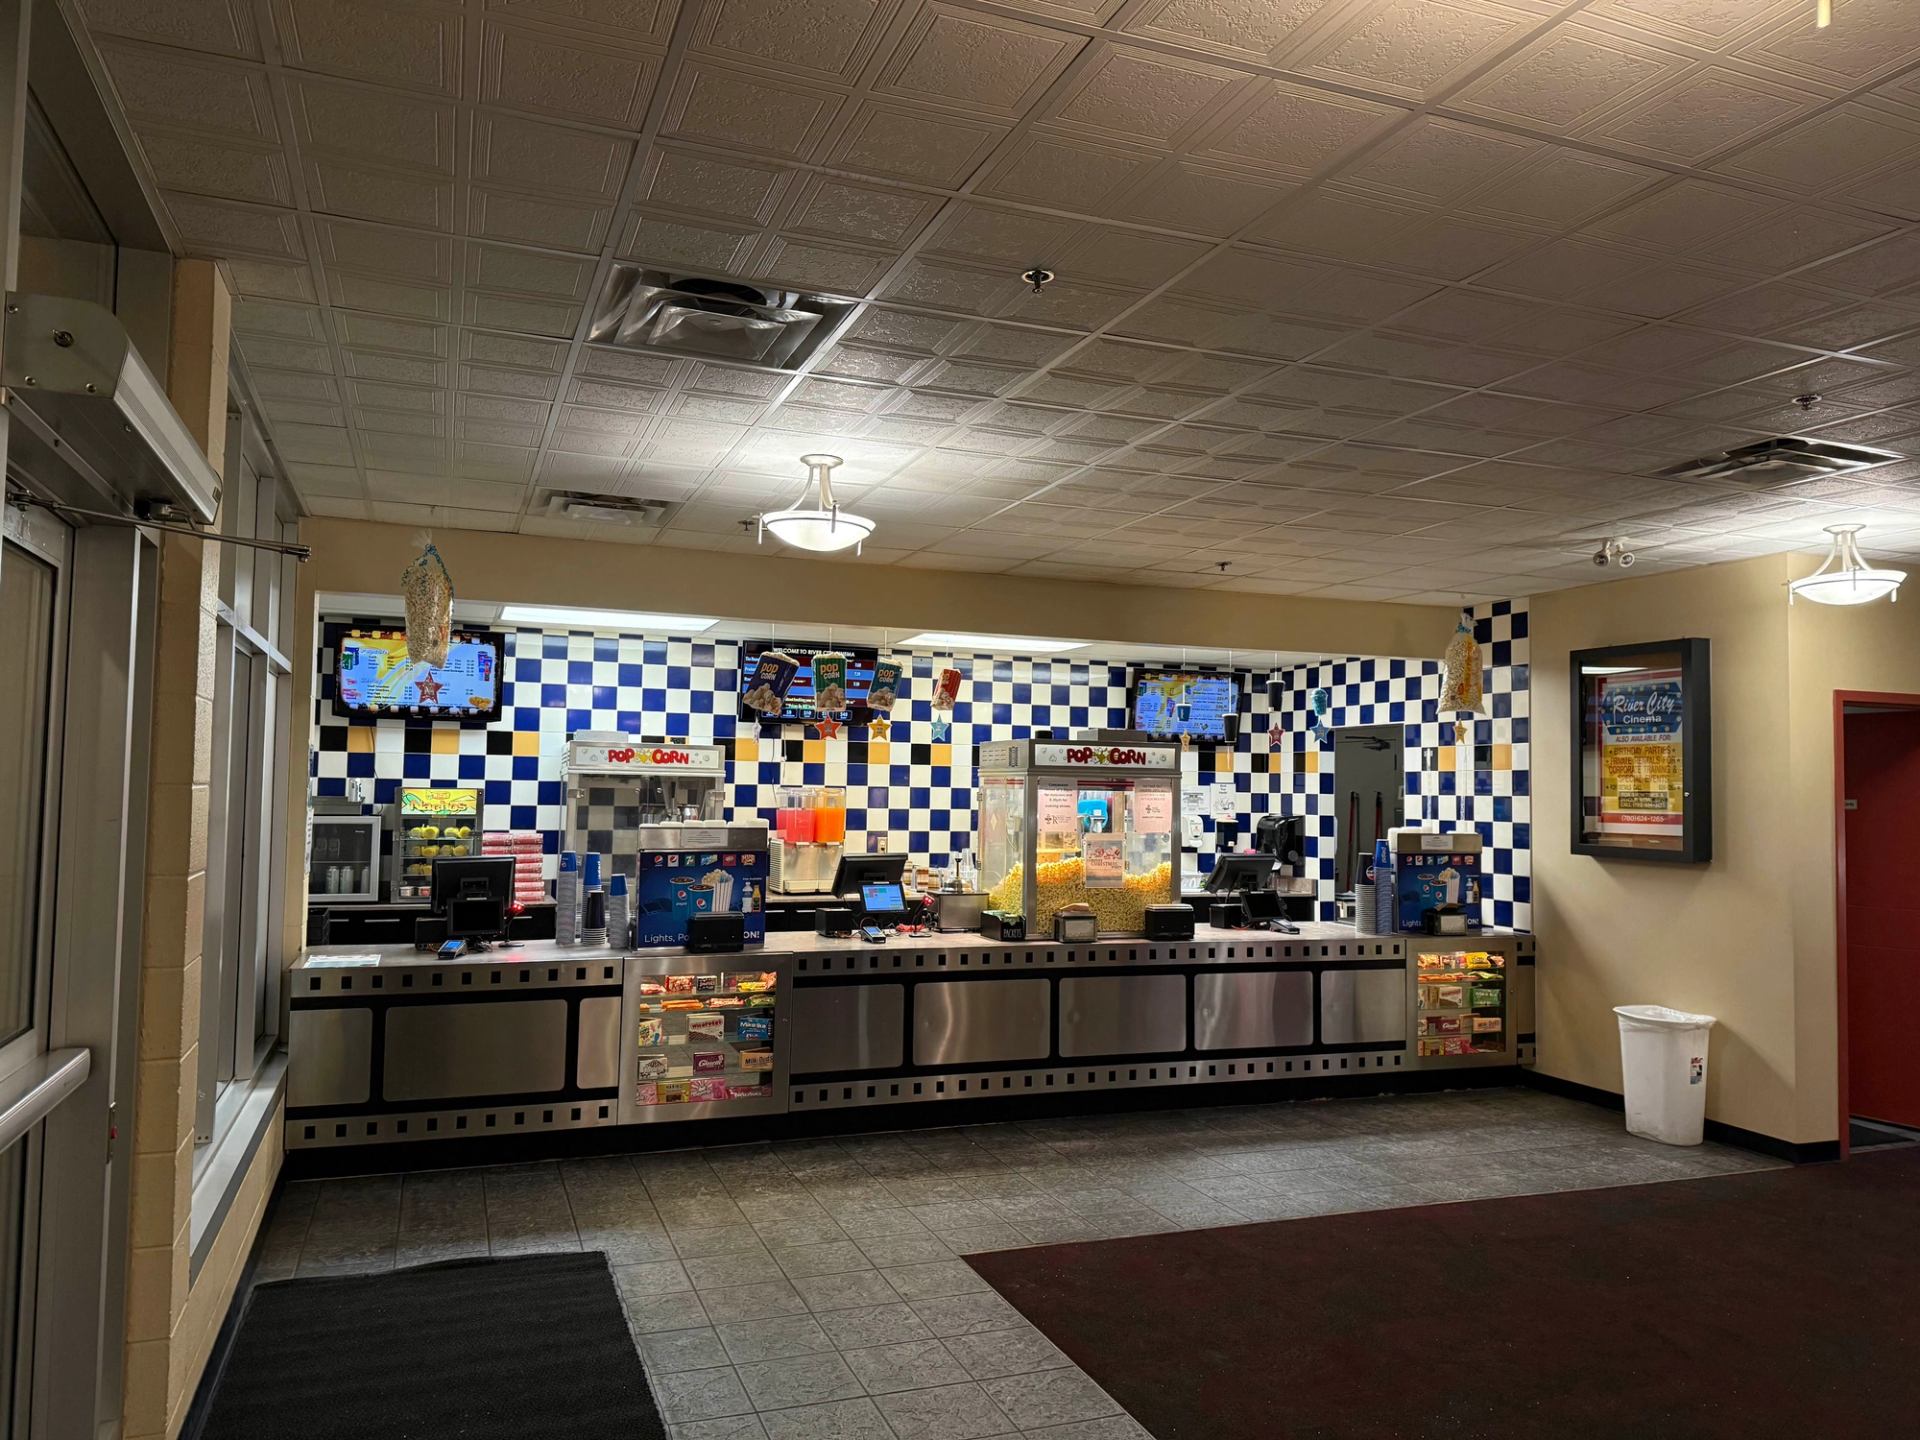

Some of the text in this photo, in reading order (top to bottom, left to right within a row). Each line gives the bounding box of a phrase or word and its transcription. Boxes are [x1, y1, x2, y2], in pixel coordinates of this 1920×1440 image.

[773, 647, 799, 655] WELCOME
[760, 672, 777, 681] CORN
[823, 670, 840, 680] CORN
[1613, 691, 1675, 715] River City
[1623, 714, 1662, 724] Cinema
[1630, 734, 1656, 742] AVAILABLE
[1614, 745, 1671, 755] BIRTHDAY PARTIES
[608, 748, 689, 764] POP CORN
[1067, 747, 1146, 765] POP CORN
[1609, 766, 1641, 775] CORPORATE
[644, 930, 760, 944] Lights, Po ON!
